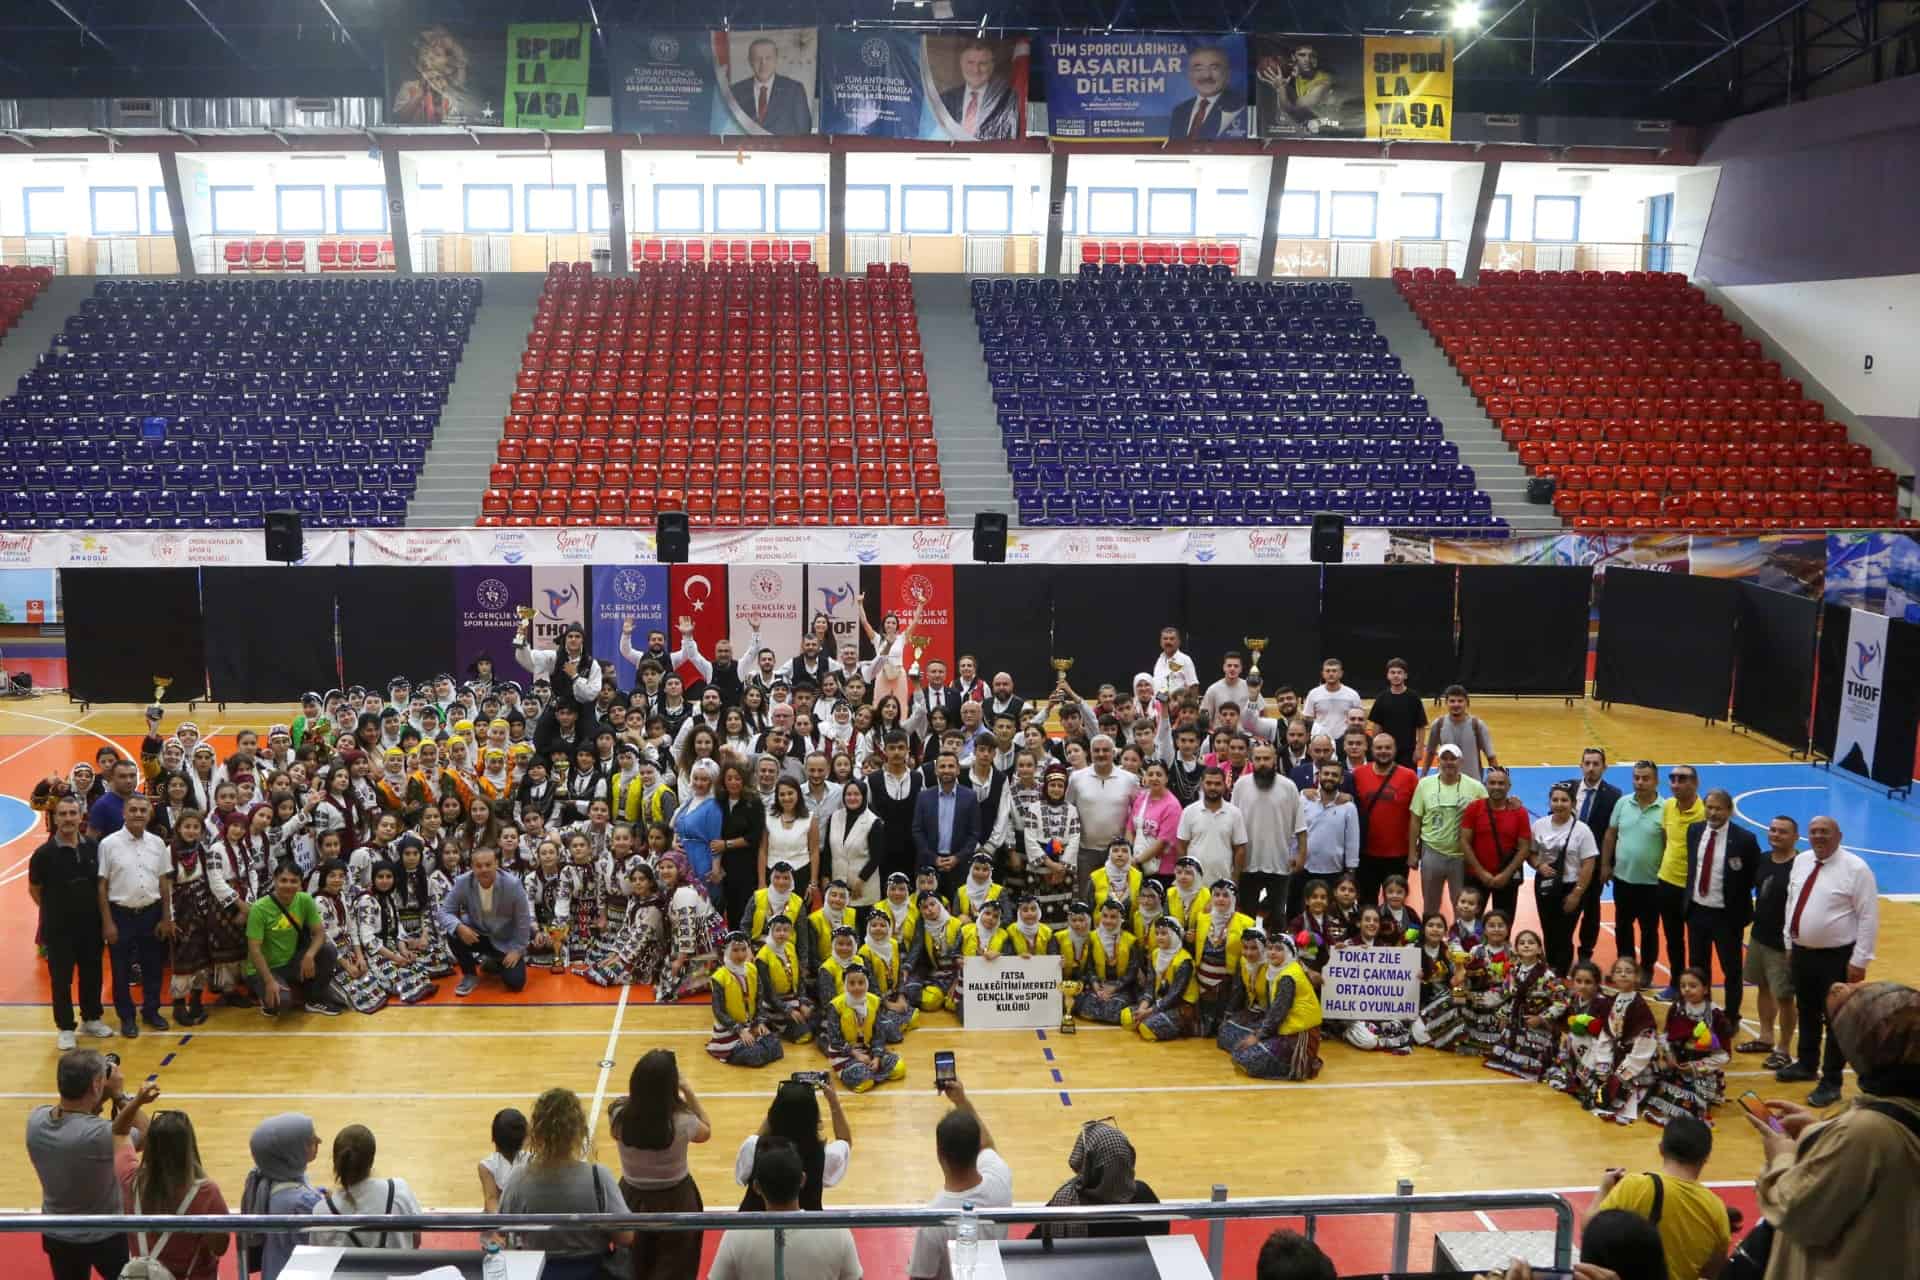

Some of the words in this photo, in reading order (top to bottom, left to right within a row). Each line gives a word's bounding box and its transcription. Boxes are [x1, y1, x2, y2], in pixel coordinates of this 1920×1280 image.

[1051, 43, 1077, 56] TÜM
[1080, 43, 1187, 56] SPORCULARIMIZA
[1057, 57, 1182, 76] BAŞARILAR
[1374, 52, 1446, 73] SPOR
[518, 63, 546, 84] LA
[1077, 77, 1165, 94] DİLERİM
[1376, 76, 1410, 97] LA
[514, 92, 580, 119] YAŞA
[1375, 103, 1444, 128] YAŞA
[1051, 201, 1062, 215] E
[1864, 354, 1873, 370] D
[615, 602, 649, 612] GENÇLİK
[752, 602, 785, 611] GENÇLİK
[478, 611, 511, 621] GENÇLİK
[536, 624, 568, 637] THO
[1847, 680, 1881, 701] THOF
[1339, 951, 1375, 963] TOKAT
[1000, 971, 1024, 980] FATSA
[1329, 965, 1360, 979] FEVZİ
[1363, 969, 1411, 982] ÇAKMAK
[968, 982, 989, 991] HALK
[1022, 980, 1056, 990] MERKEZİ
[1336, 984, 1404, 997] ORTAOKULU
[977, 992, 1013, 1003] GENÇLİK
[1025, 992, 1048, 1001] SPOR
[996, 1002, 1030, 1011] KULÜBÜ
[1325, 1000, 1356, 1011] HALK
[1360, 1001, 1415, 1013] OYUNLARI
